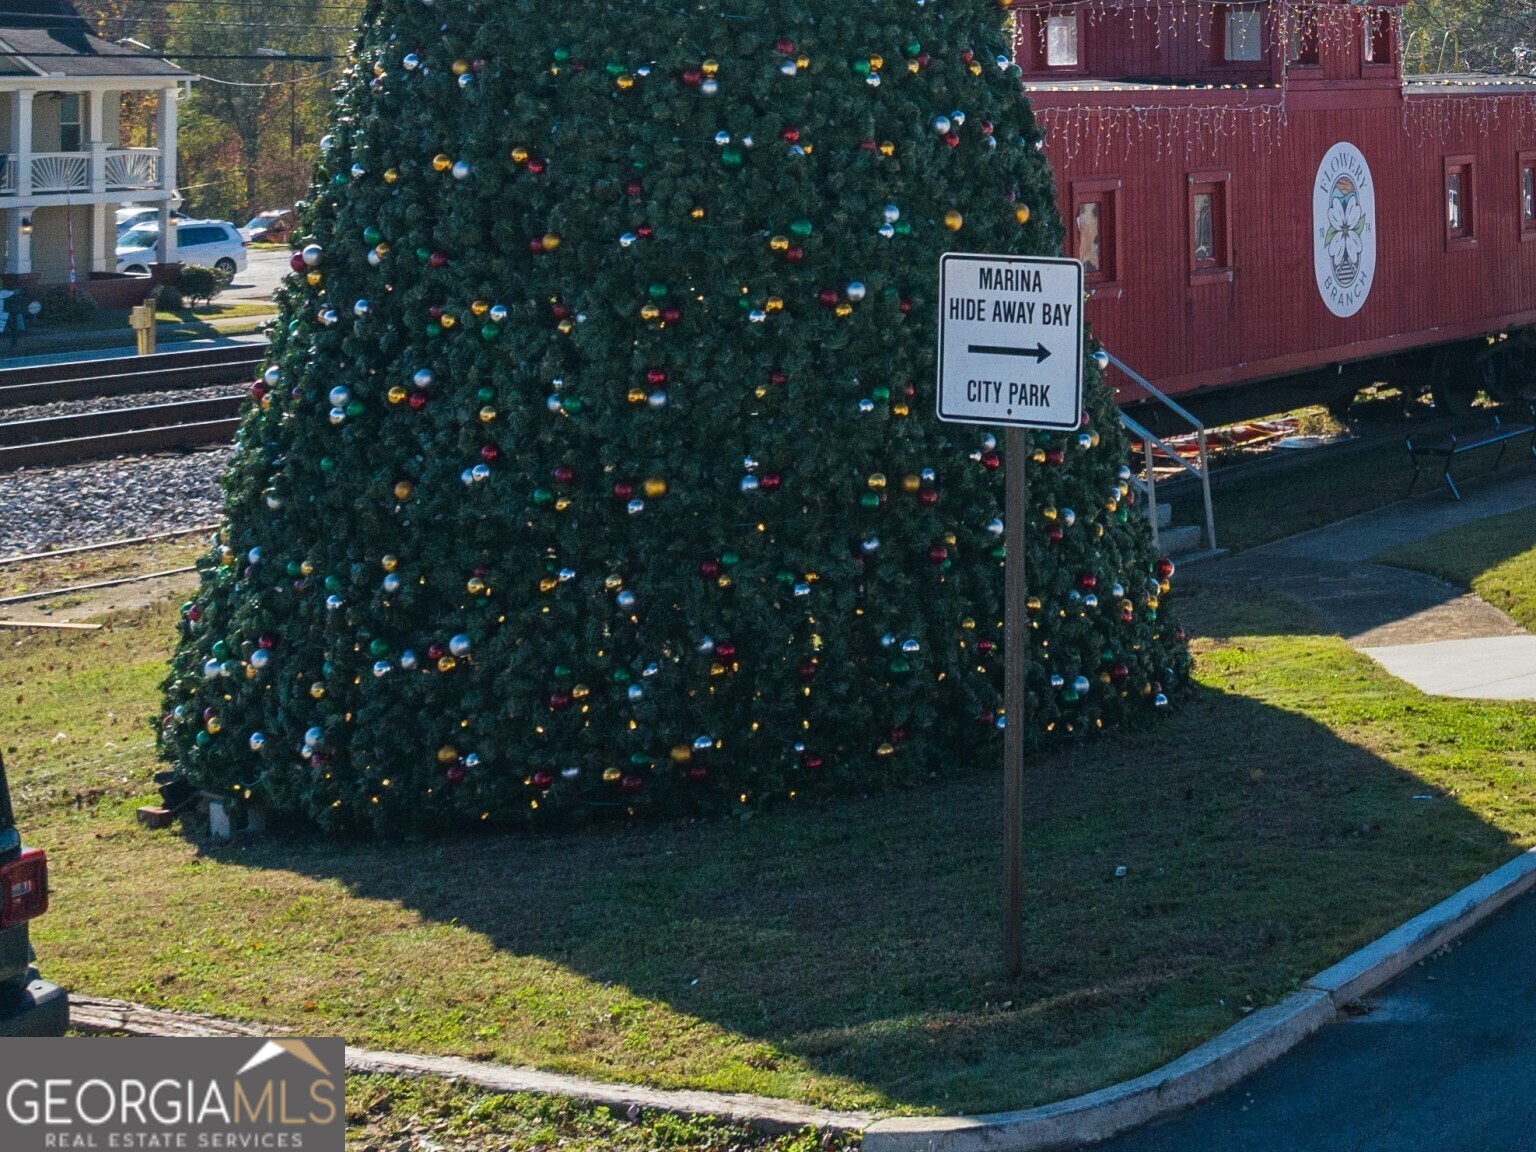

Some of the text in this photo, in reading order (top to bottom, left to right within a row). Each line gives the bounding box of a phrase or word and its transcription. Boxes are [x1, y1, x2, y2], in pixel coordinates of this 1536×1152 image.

[1320, 152, 1368, 193] FLOWERY
[979, 267, 1043, 293] MARINA
[1324, 271, 1367, 307] BRANCH
[949, 297, 1073, 327] HIDE AWAY BAY
[966, 379, 1051, 408] CITY PARK
